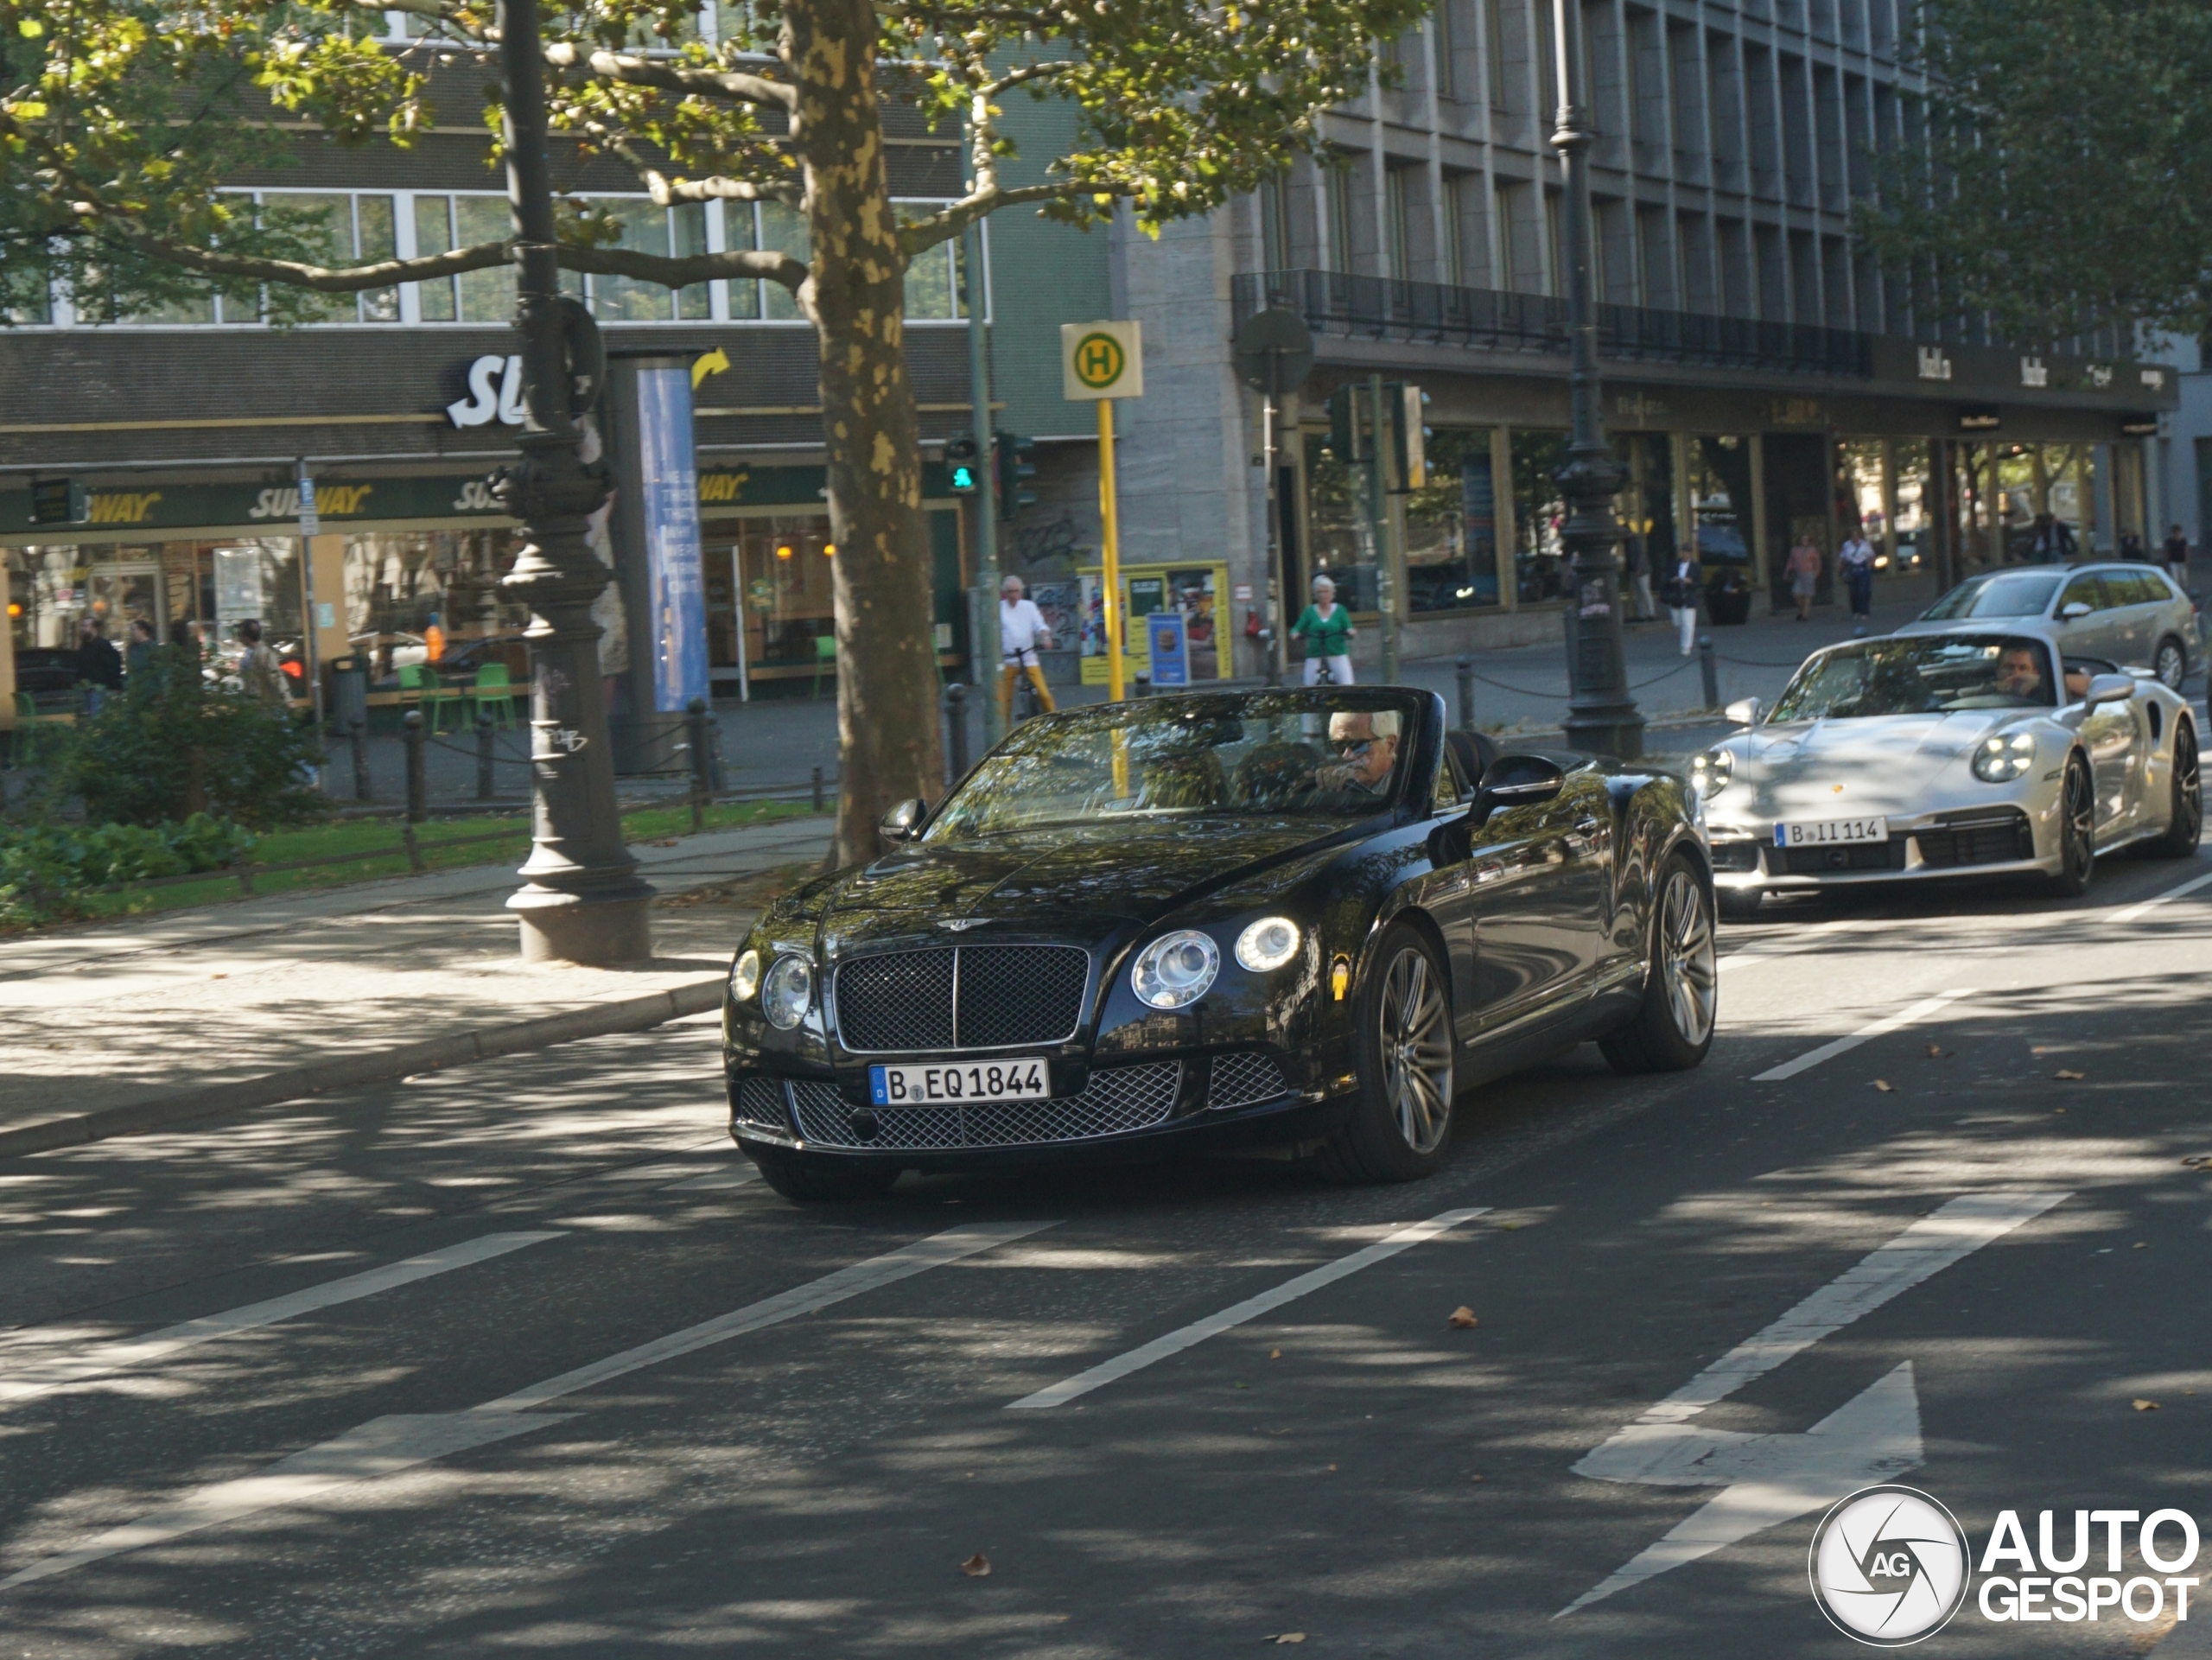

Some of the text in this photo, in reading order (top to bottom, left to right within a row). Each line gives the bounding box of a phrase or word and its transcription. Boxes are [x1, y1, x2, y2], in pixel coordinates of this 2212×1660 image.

[1086, 345, 1110, 376] H
[1791, 825, 1803, 843] B
[888, 1071, 907, 1100] B
